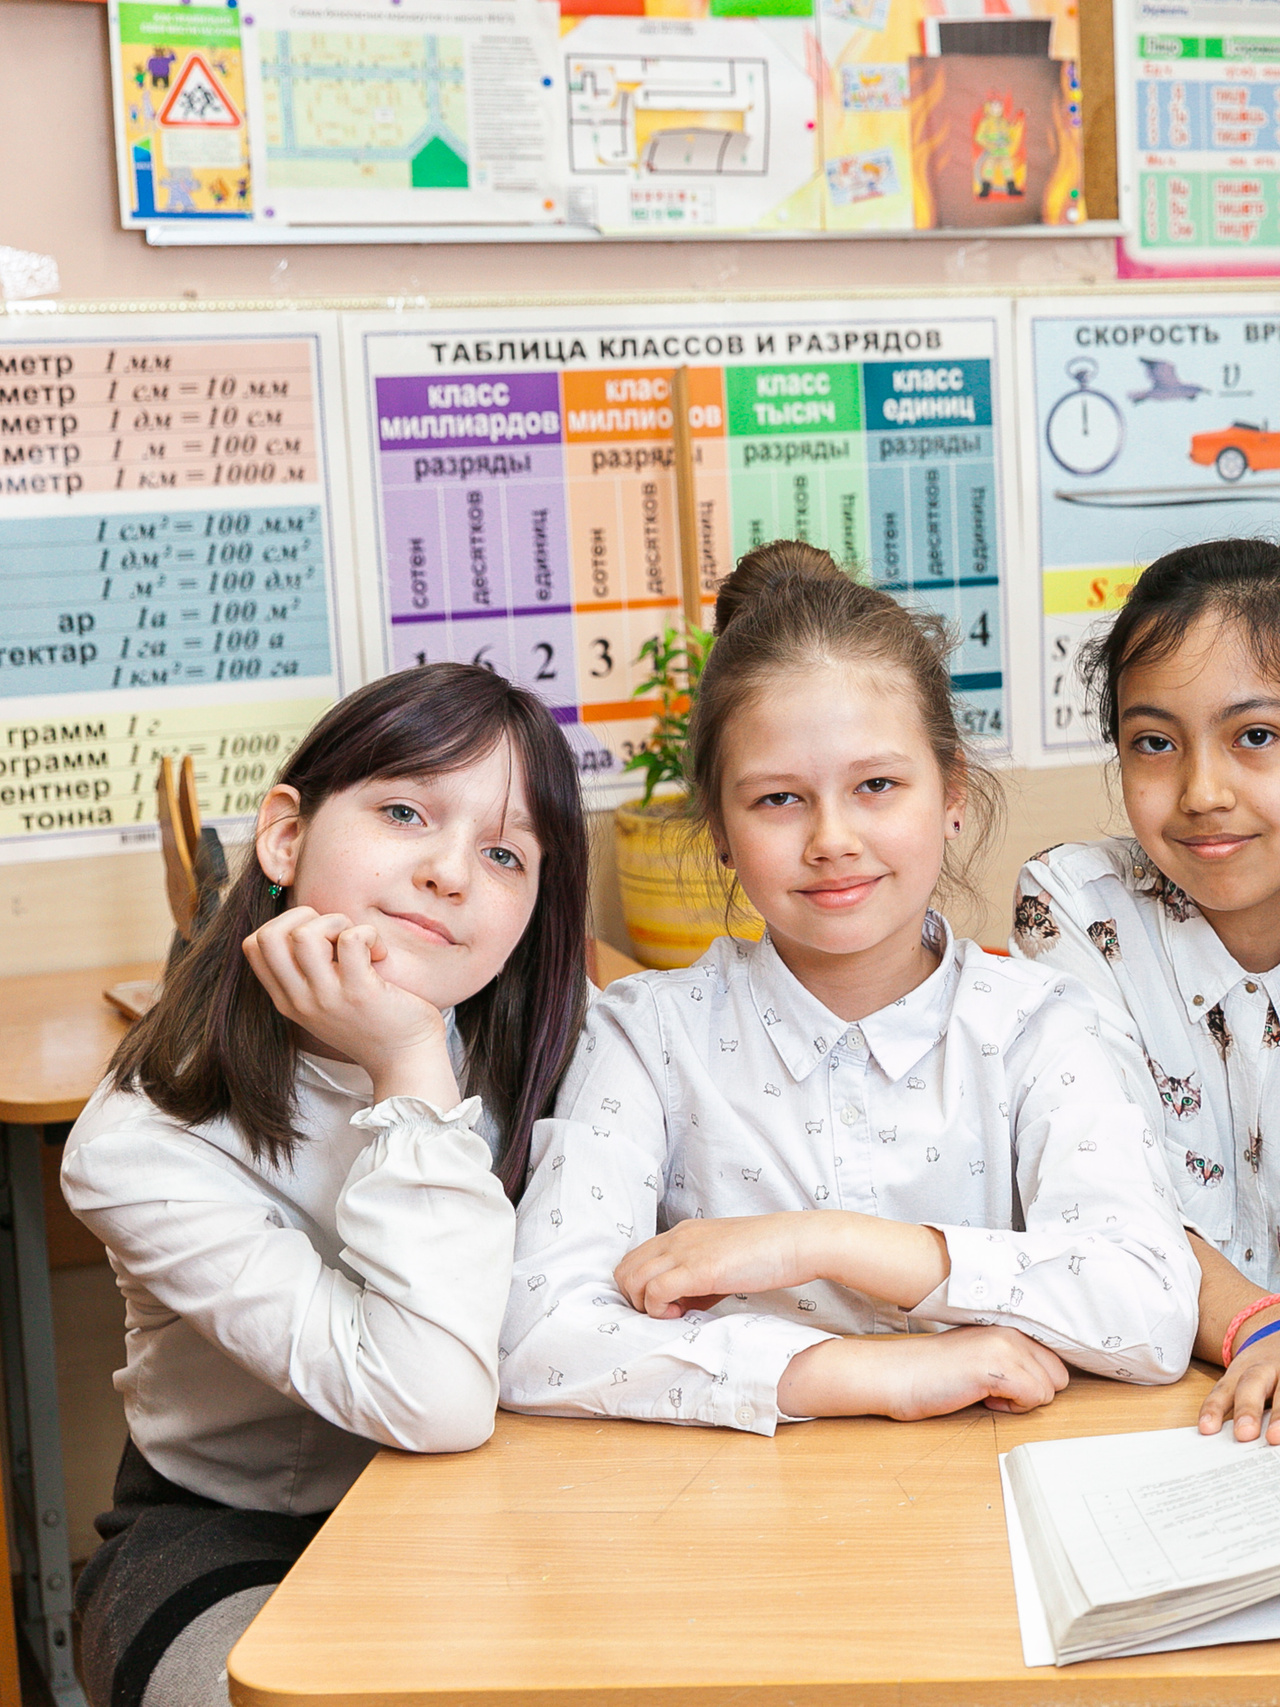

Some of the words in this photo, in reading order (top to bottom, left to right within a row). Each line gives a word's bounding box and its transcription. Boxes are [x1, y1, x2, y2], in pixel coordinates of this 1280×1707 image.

[431, 340, 586, 365] ТАБЛИЦА
[600, 335, 744, 358] КЛАССОВ
[757, 333, 774, 353] И
[787, 330, 942, 353] РАЗРЯДОВ
[1076, 324, 1220, 346] СКОРОСТЬ
[104, 350, 115, 372] 1
[124, 354, 172, 373] мм
[0, 383, 75, 406] метр
[108, 379, 118, 400] 1
[132, 384, 169, 400] см
[206, 376, 237, 398] 10
[242, 380, 289, 397] мм
[605, 378, 673, 402] клас
[757, 372, 830, 396] класс
[893, 368, 963, 392] класс
[428, 383, 509, 409] класс
[883, 396, 975, 423] единиц
[1, 413, 78, 437] метр
[110, 409, 120, 430] 1
[134, 411, 171, 430] дм
[209, 407, 239, 428] 10
[247, 410, 282, 427] см
[381, 411, 560, 443] миллиардов
[568, 405, 722, 433] миллиоов
[754, 401, 835, 425] тысяч
[4, 443, 81, 467] метр
[112, 438, 123, 461] 1
[143, 444, 165, 460] м
[210, 436, 258, 457] 100
[266, 439, 302, 455] см
[592, 447, 703, 475] разряд
[744, 440, 849, 467] разряды
[880, 436, 981, 461] разряды
[0, 471, 82, 498] метр
[115, 468, 125, 490] 1
[139, 471, 177, 488] км
[211, 464, 276, 485] 1000
[282, 467, 305, 482] м
[415, 452, 531, 481] разряды
[96, 518, 108, 543] 1
[203, 513, 250, 536] 100
[926, 469, 944, 576] десятков
[972, 486, 988, 573] единиц
[468, 490, 490, 606] десятков
[642, 483, 663, 594] десятков
[884, 512, 901, 579] сотен
[99, 548, 110, 572] 1
[206, 543, 253, 565] 100
[533, 508, 550, 602] единиц
[591, 527, 608, 598] сотен
[102, 577, 112, 600] 1
[208, 571, 255, 593] 100
[410, 537, 427, 609] сотен
[58, 611, 96, 636] ар
[210, 601, 257, 624] 100
[968, 609, 991, 647] 4
[212, 630, 259, 653] 100
[215, 659, 262, 681] 100
[532, 642, 557, 681] 2
[591, 638, 613, 678] 3
[8, 720, 106, 750] грамм
[128, 715, 139, 737] 1
[130, 743, 141, 765] 1
[217, 735, 280, 759] 1000
[131, 772, 141, 793] 1
[219, 763, 265, 786] 100
[22, 803, 112, 831] тонна
[133, 801, 143, 821] 1
